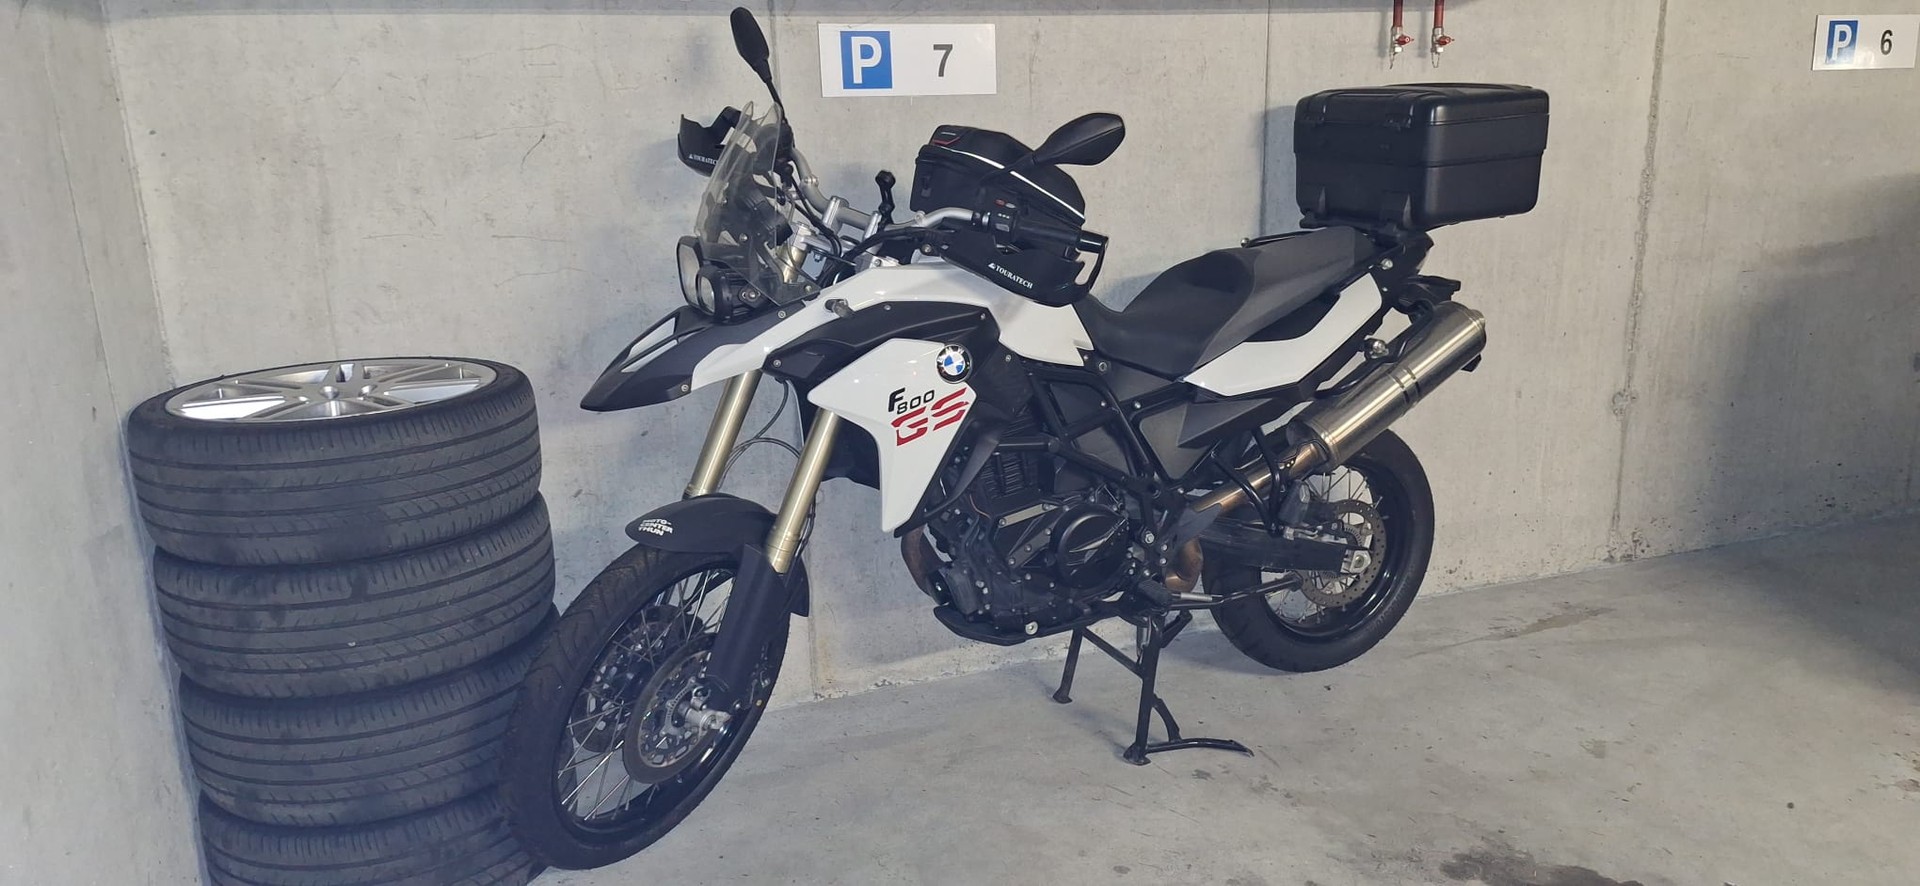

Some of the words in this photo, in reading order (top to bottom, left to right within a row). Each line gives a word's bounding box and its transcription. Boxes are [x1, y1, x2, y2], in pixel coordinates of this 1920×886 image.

[850, 36, 882, 84] P
[933, 44, 953, 77] 7
[1831, 24, 1852, 61] P
[1880, 29, 1893, 55] 6
[995, 264, 1034, 289] TOURATECH
[888, 387, 906, 412] F
[897, 389, 935, 415] 800
[891, 387, 970, 446] GS
